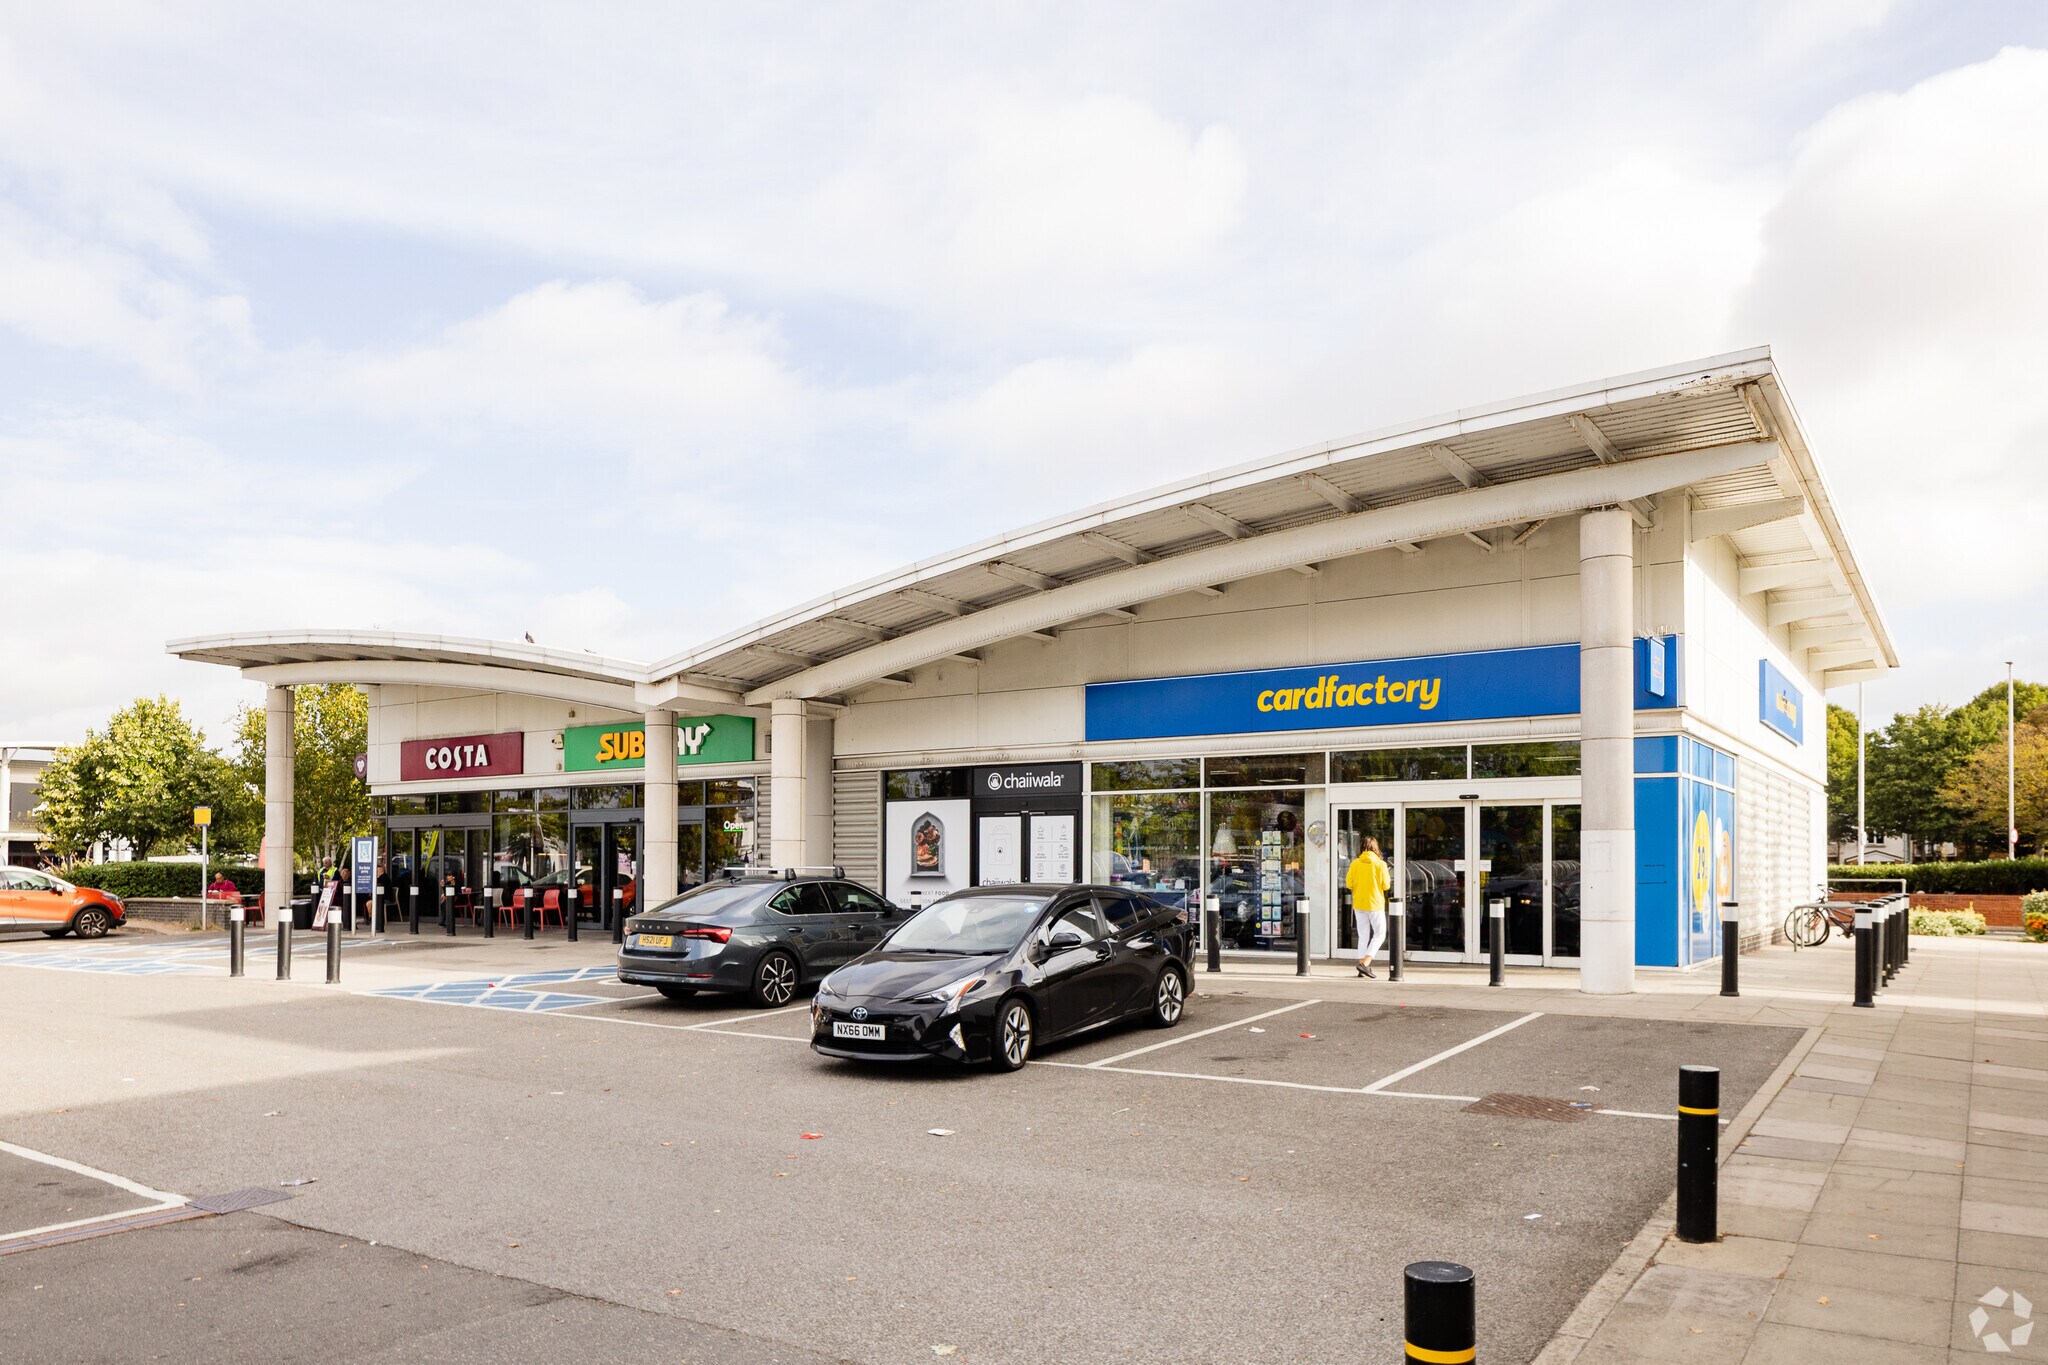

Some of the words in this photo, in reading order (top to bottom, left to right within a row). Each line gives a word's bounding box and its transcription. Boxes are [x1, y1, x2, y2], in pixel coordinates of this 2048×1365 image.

[1257, 675, 1441, 711] cardfactory
[425, 743, 489, 771] COSTA
[595, 723, 712, 763] SUBAY
[723, 820, 745, 832] Open
[837, 1024, 860, 1036] NX66
[862, 1026, 881, 1037] OMM
